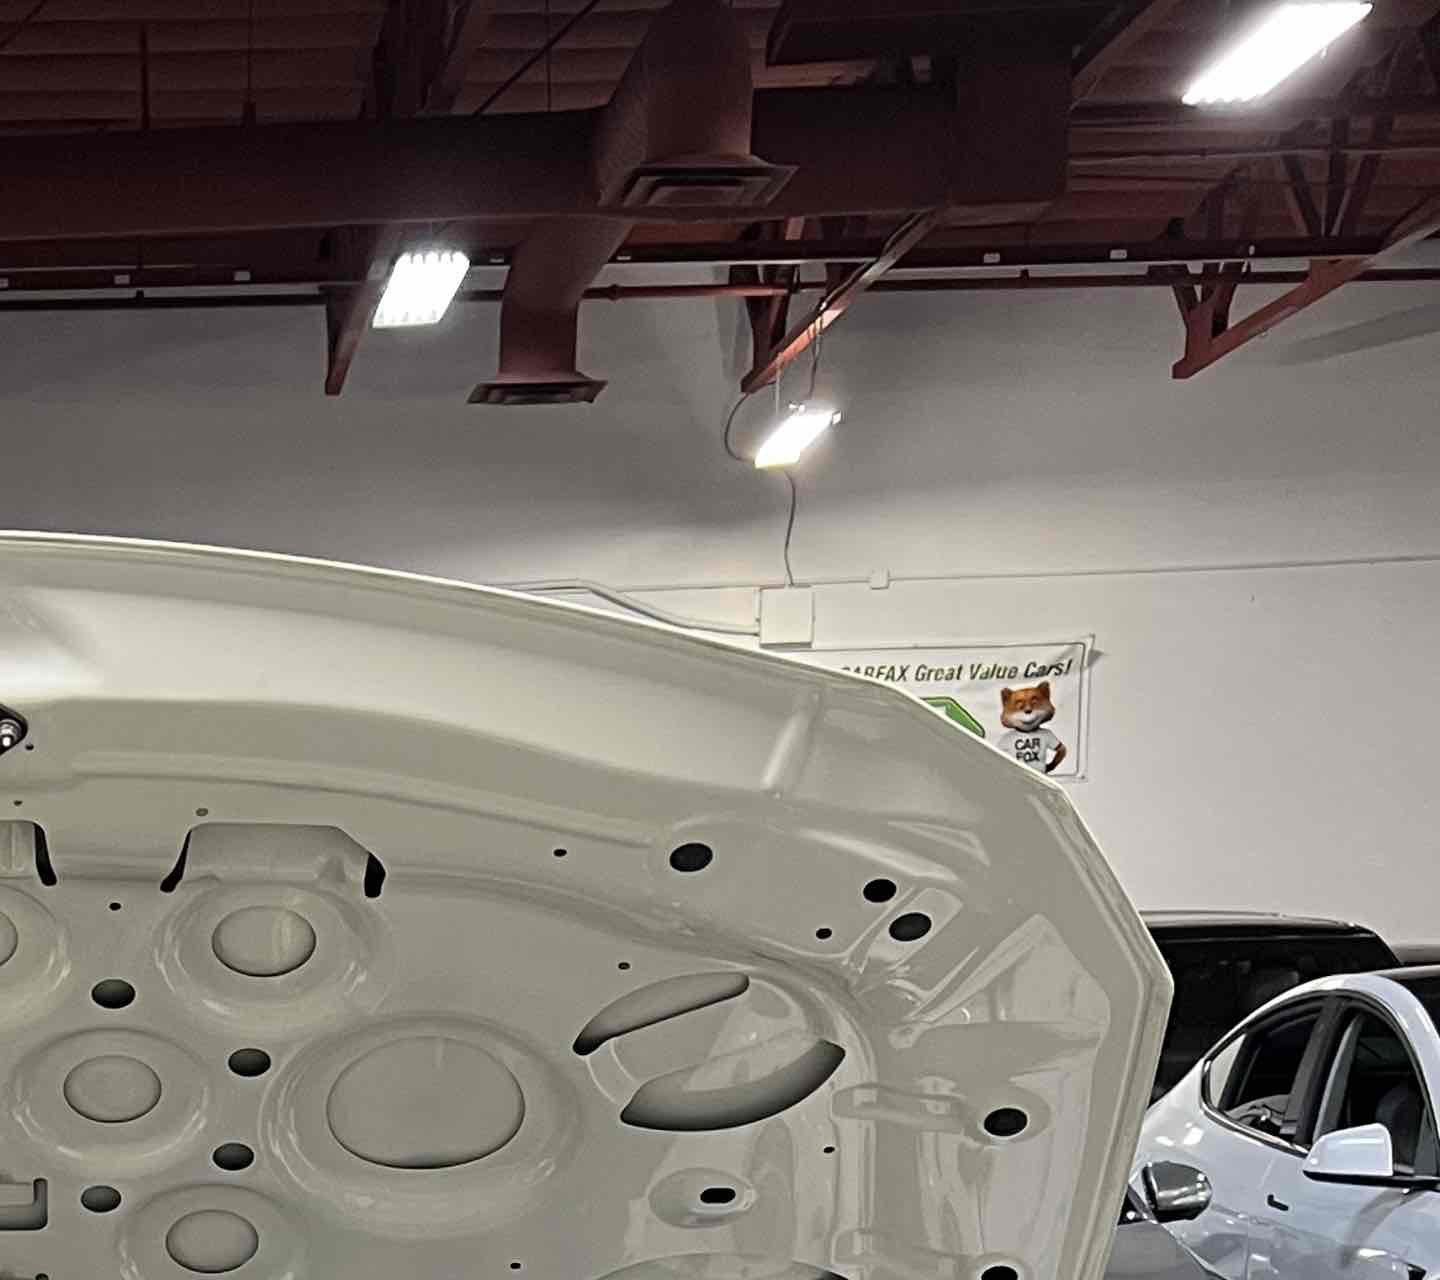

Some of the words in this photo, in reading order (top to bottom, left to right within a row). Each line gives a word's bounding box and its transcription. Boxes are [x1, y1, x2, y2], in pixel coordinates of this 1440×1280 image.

[841, 664, 910, 682] RFAX
[914, 663, 963, 682] Great
[968, 662, 1019, 681] Value
[1023, 657, 1073, 679] Cars!
[1014, 737, 1041, 750] CAR
[1015, 750, 1041, 762] FOX
